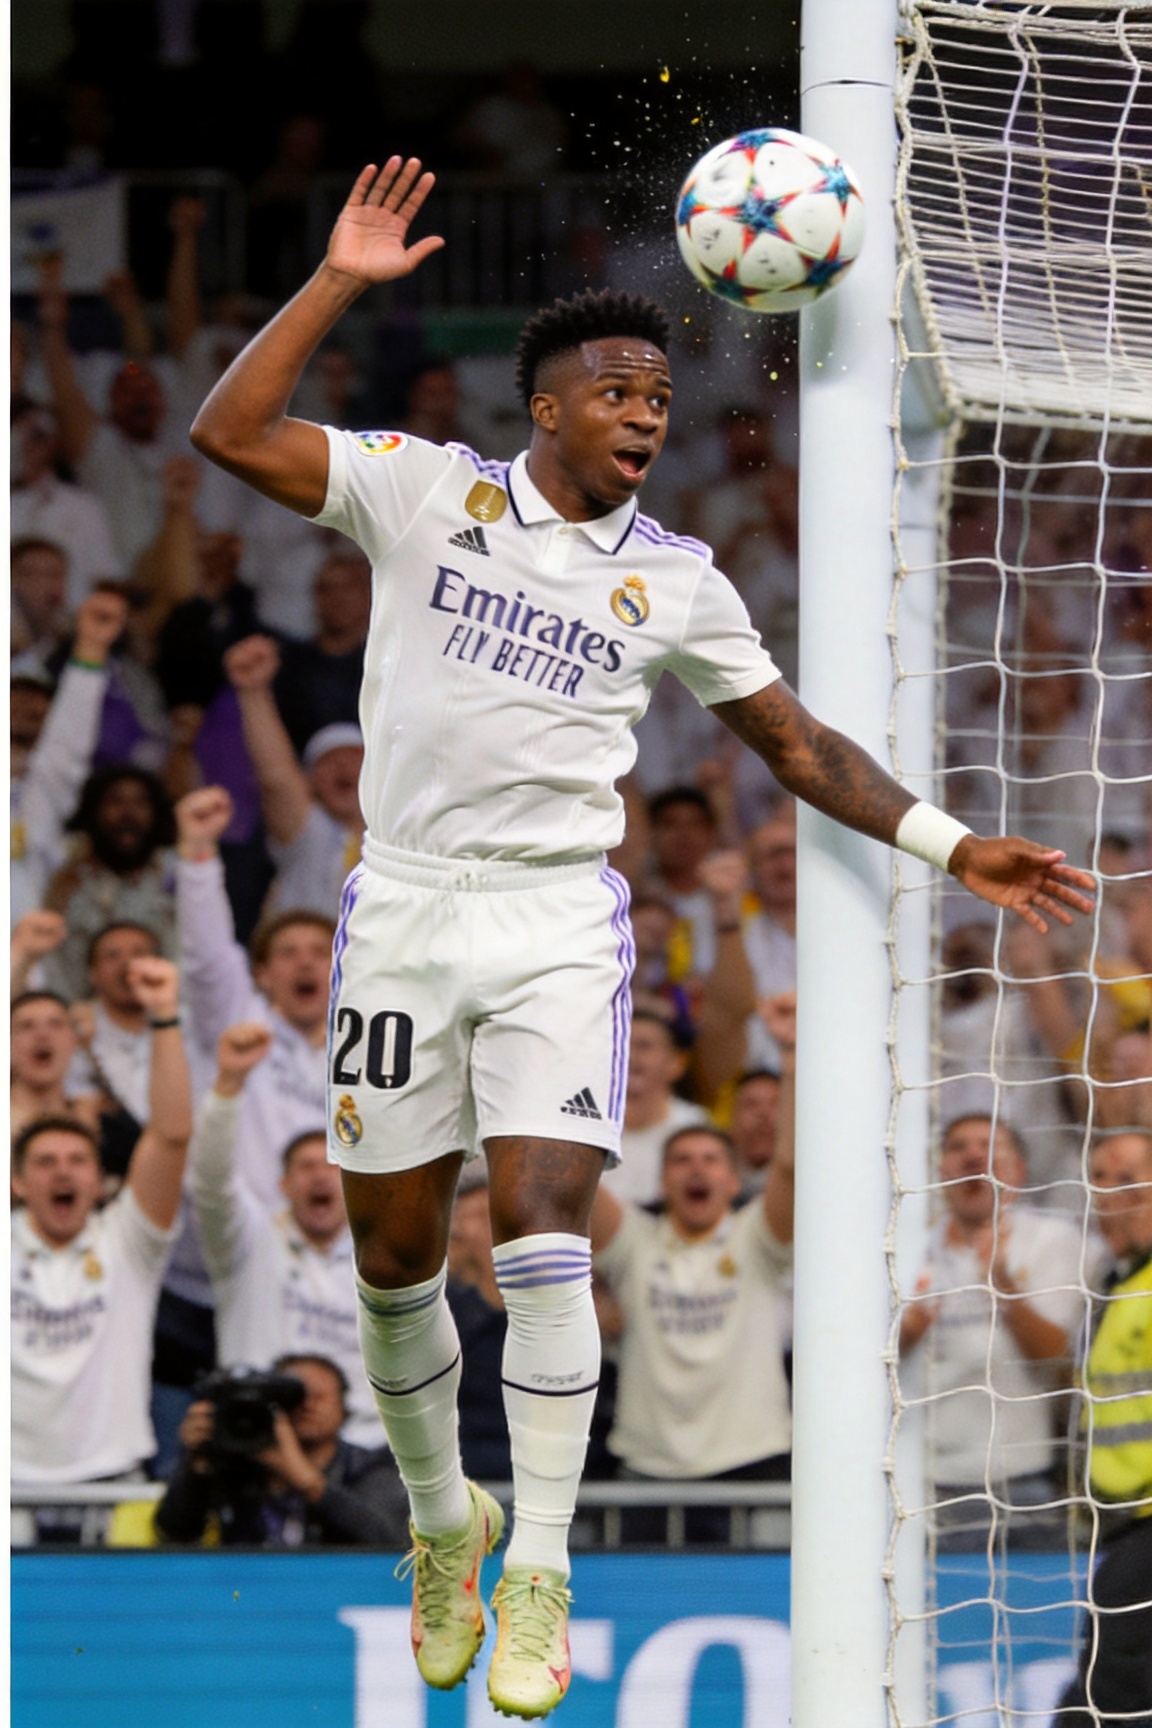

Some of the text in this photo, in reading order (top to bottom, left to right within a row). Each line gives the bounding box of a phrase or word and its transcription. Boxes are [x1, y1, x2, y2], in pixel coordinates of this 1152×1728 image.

[429, 564, 625, 673] Emirates
[442, 624, 585, 698] FLY BETTER
[332, 1007, 414, 1090] 20
